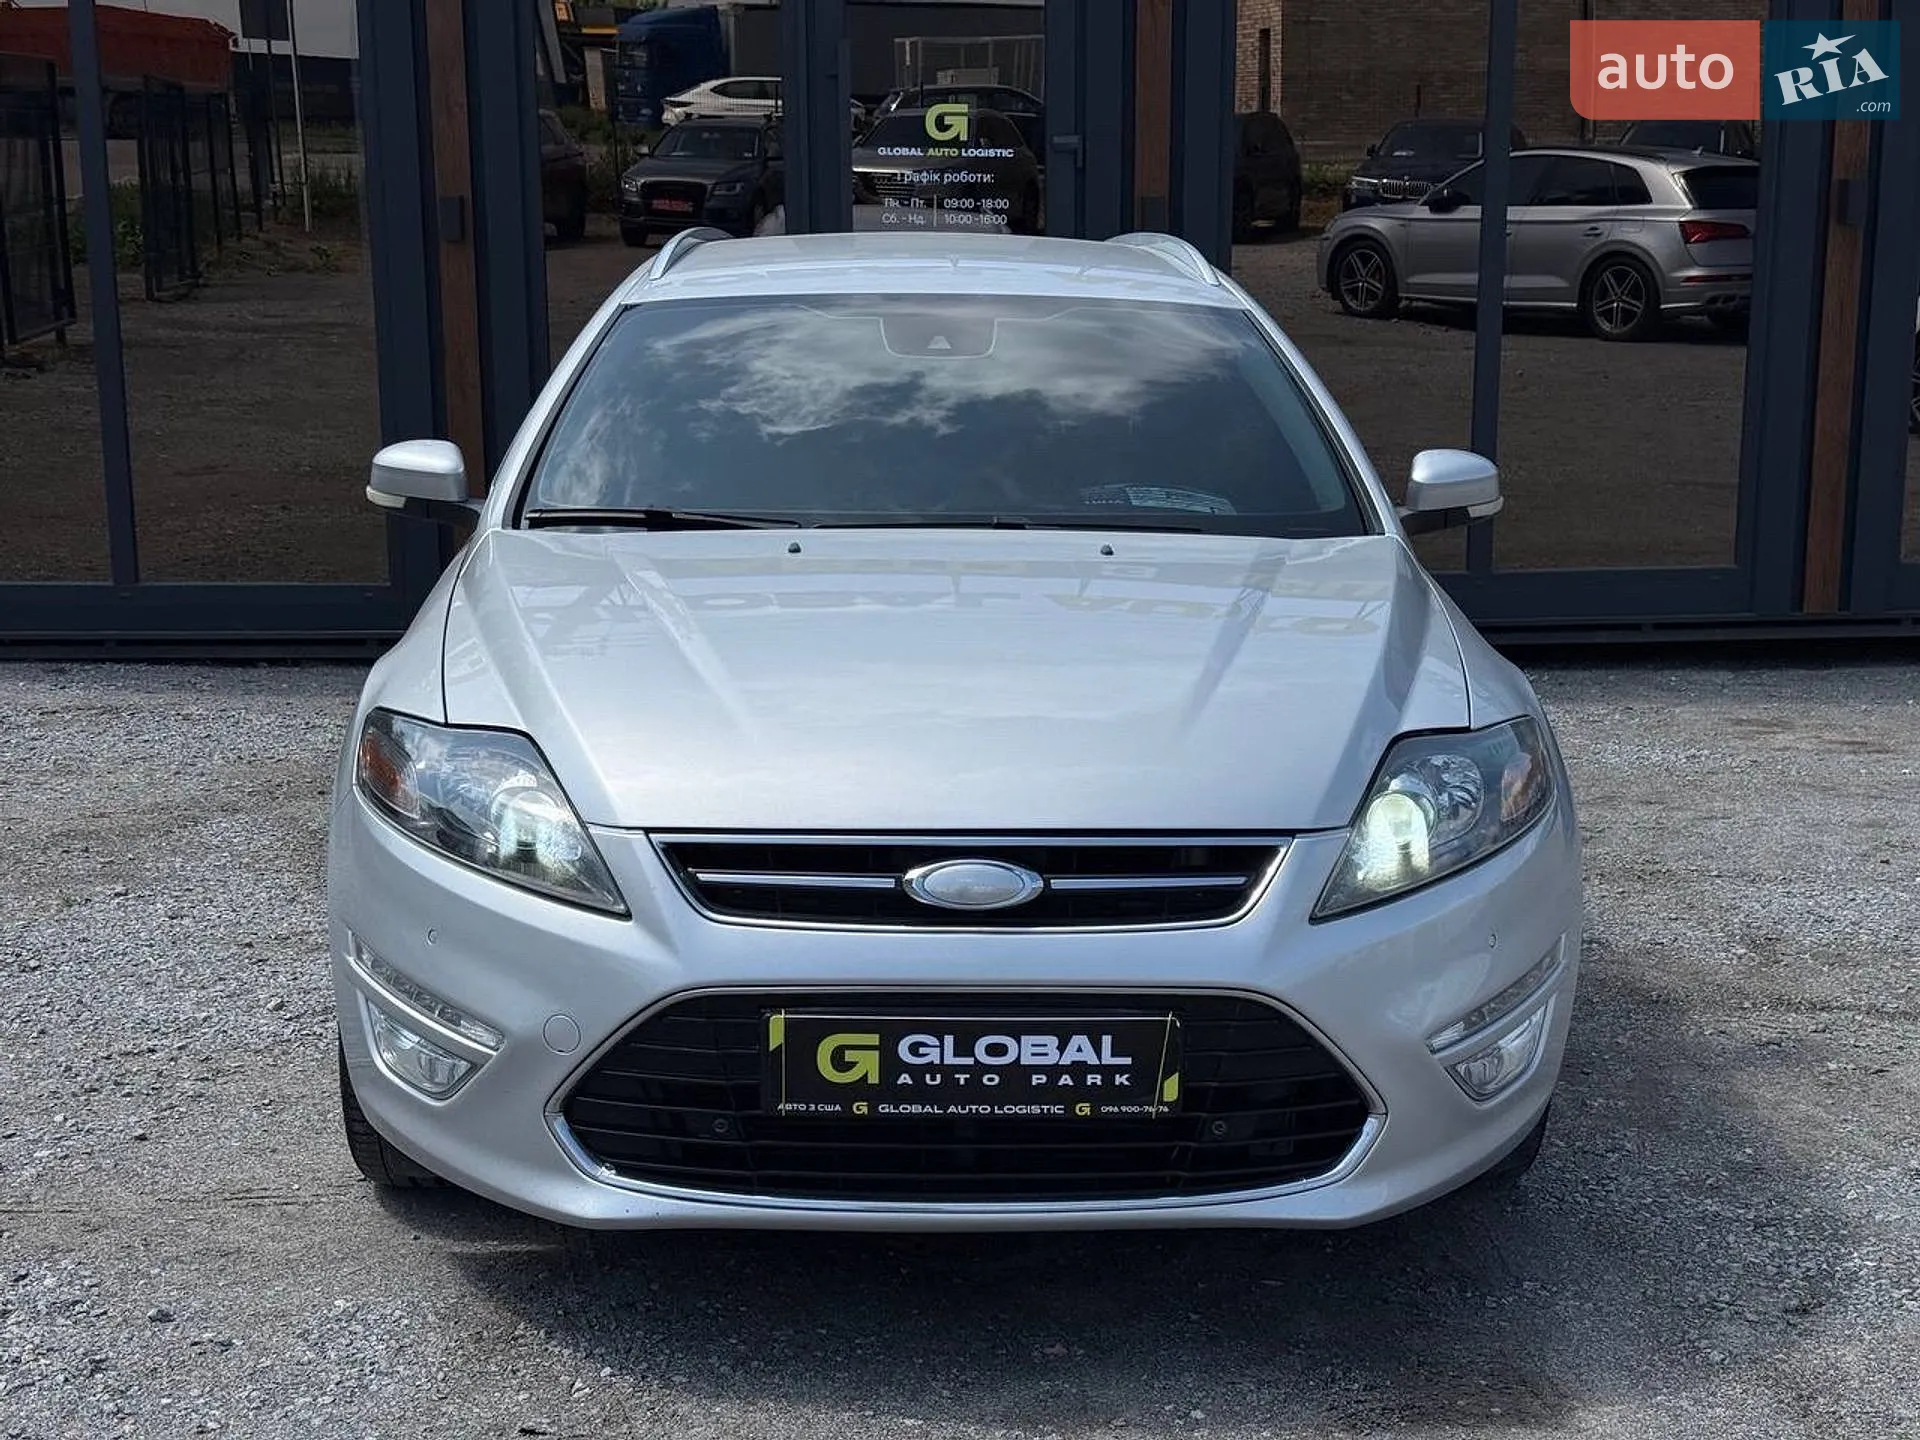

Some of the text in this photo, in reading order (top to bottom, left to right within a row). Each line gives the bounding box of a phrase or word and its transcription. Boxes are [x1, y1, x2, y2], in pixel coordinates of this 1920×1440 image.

[877, 147, 1015, 158] GLOBAL AUTO LOGISTIC
[943, 171, 995, 185] роботи:
[897, 1034, 1132, 1065] GLOBAL
[896, 1073, 1132, 1086] AUTO PARK
[878, 1103, 944, 1113] GLOBAL
[946, 1104, 991, 1114] AUTO
[994, 1105, 1065, 1115] LOGISTIC
